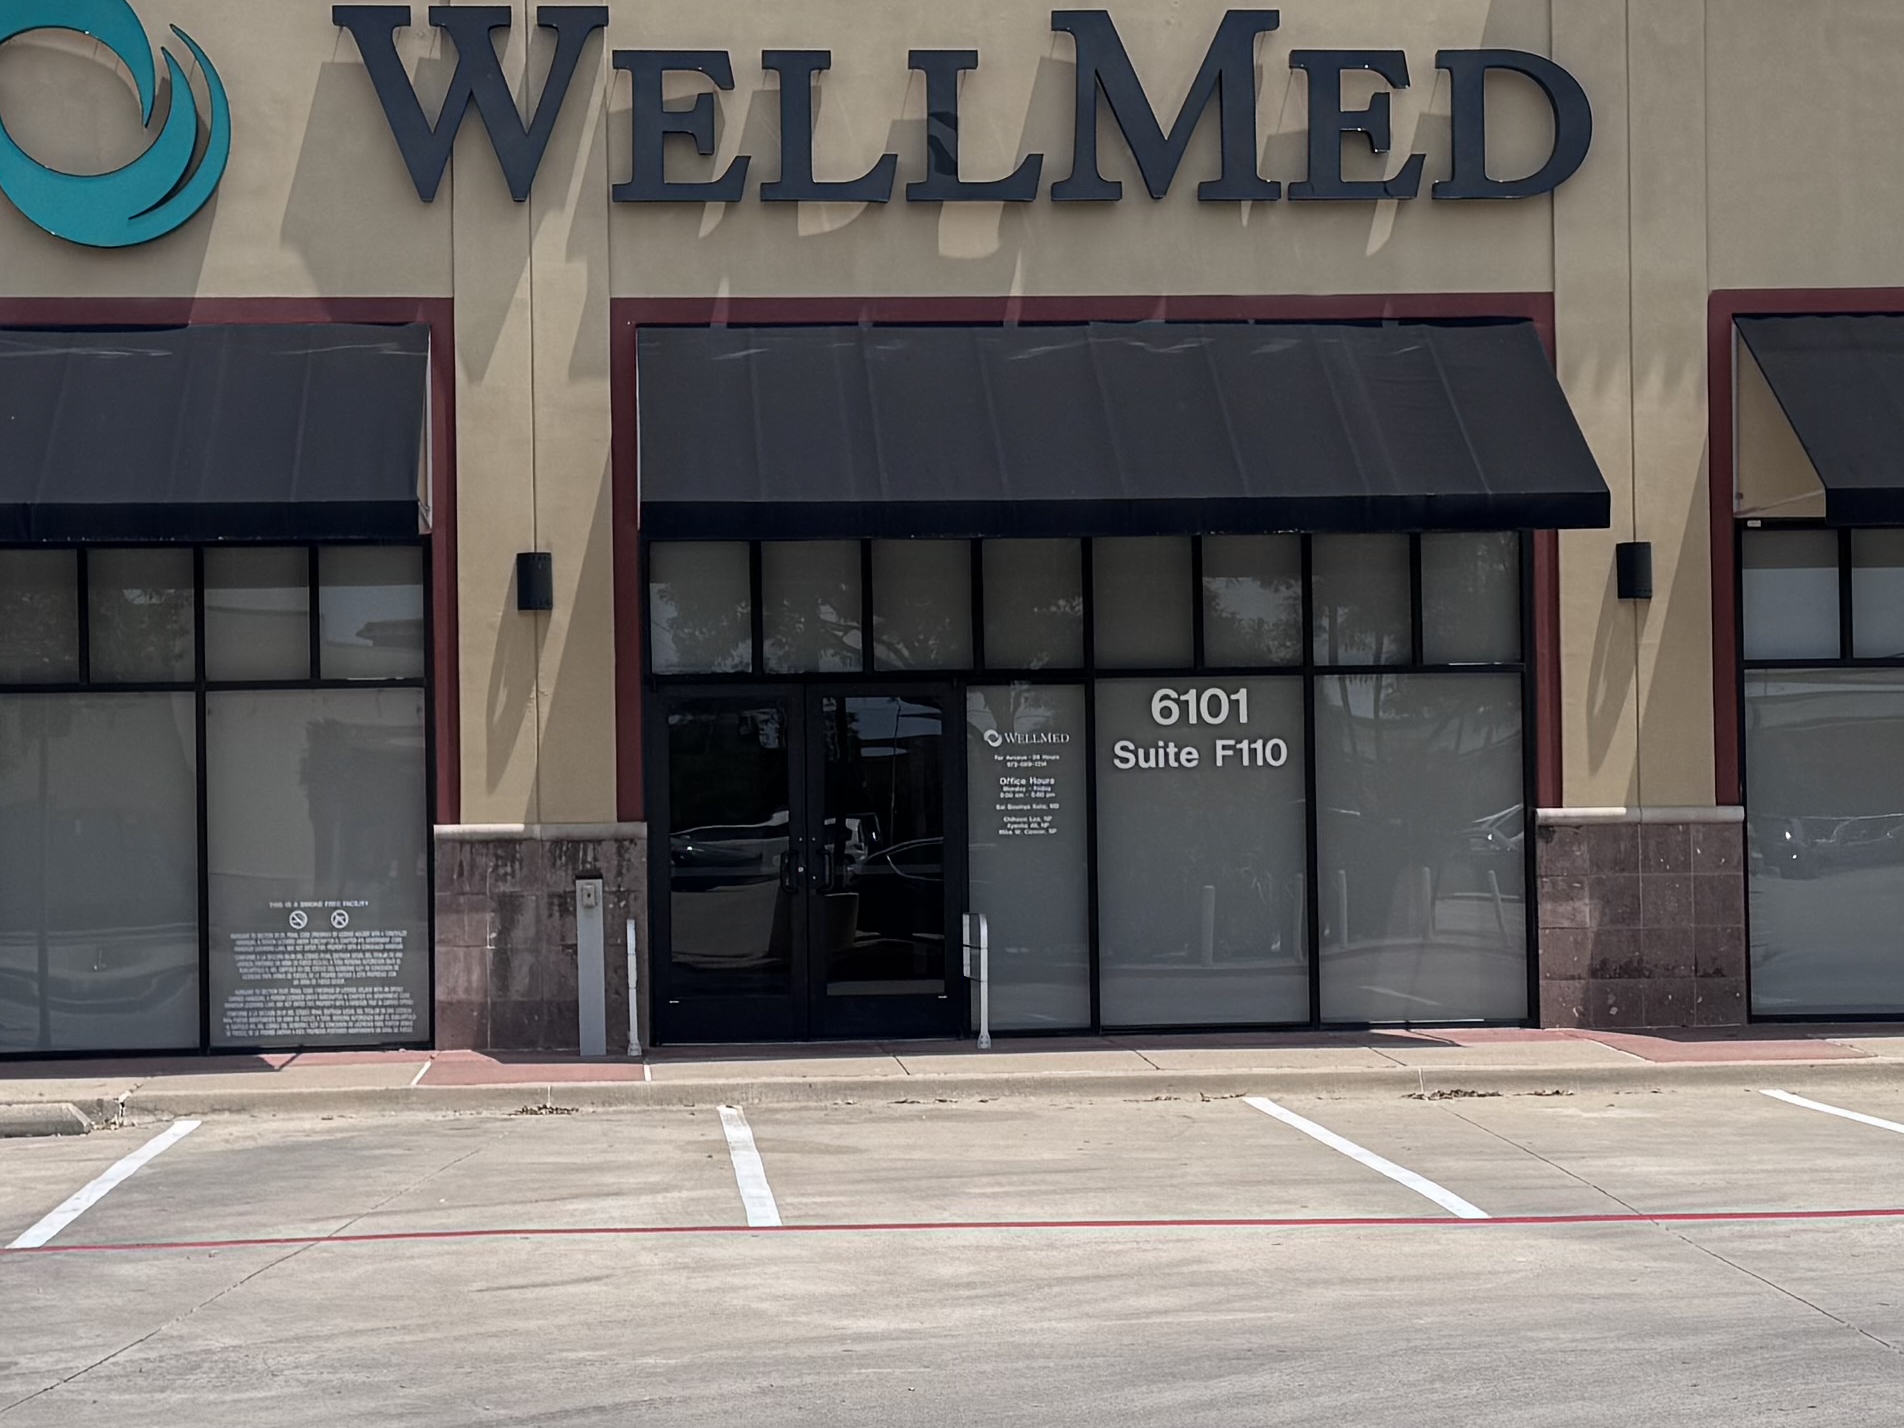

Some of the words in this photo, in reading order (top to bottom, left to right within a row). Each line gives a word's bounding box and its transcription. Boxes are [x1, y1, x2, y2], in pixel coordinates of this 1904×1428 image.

[1151, 687, 1248, 725] 6101
[1113, 740, 1200, 769] Suite
[1215, 738, 1288, 767] F110
[999, 776, 1026, 785] Office
[1029, 776, 1055, 785] Hours
